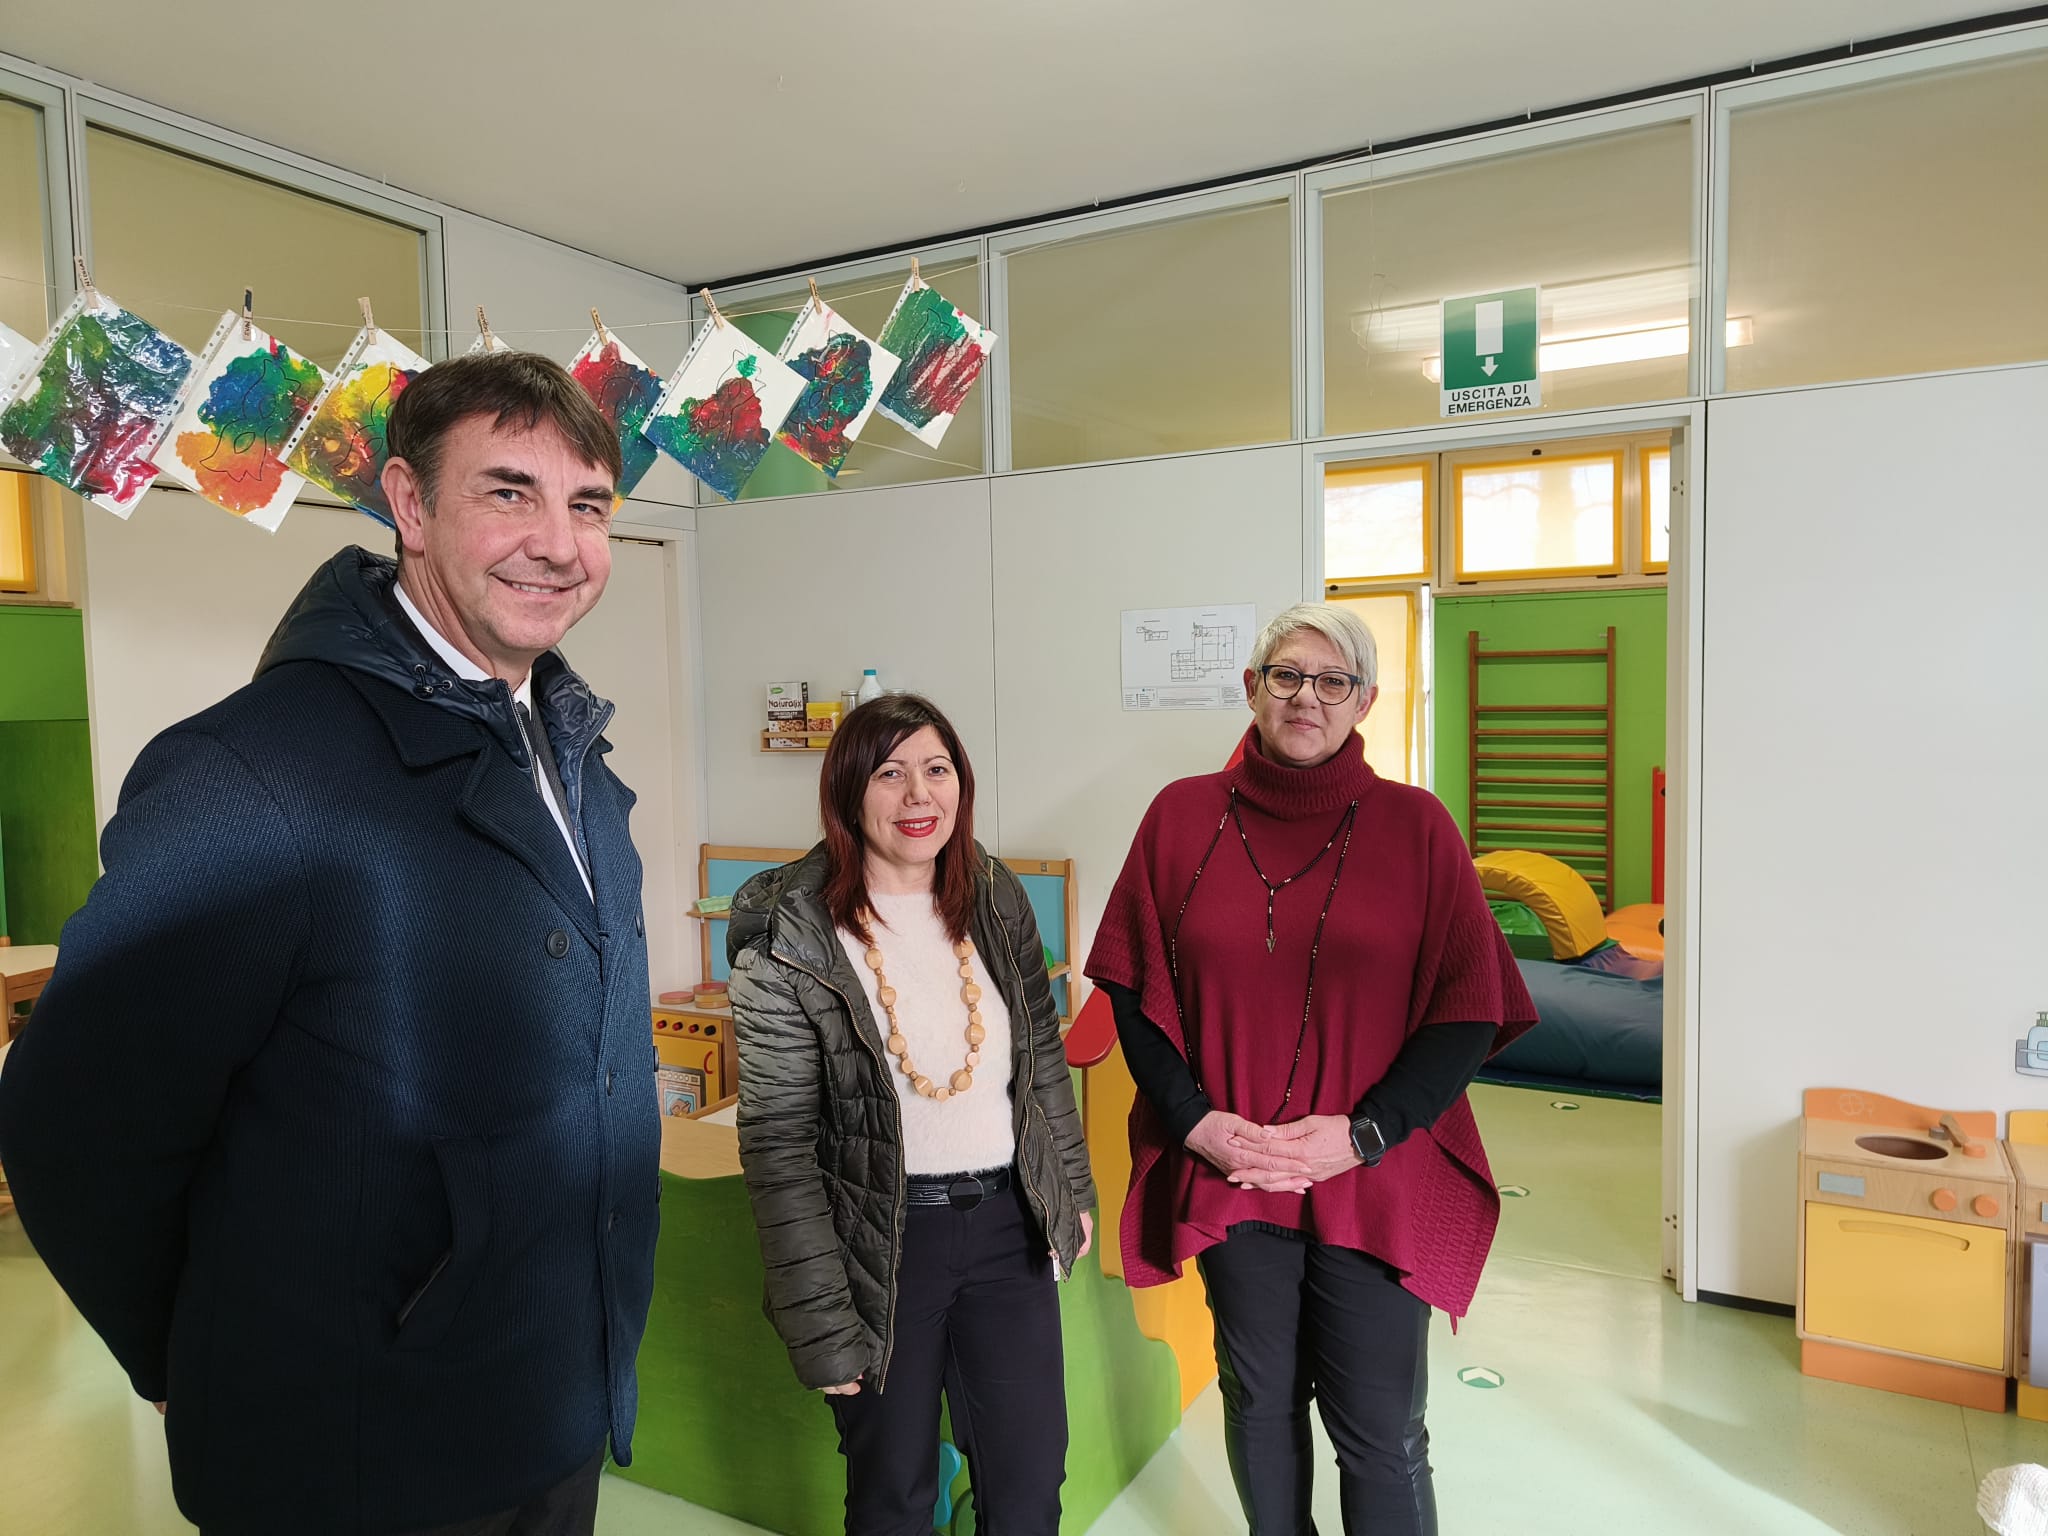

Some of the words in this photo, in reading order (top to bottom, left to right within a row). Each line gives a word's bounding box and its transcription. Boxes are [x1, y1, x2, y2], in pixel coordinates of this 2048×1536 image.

[1451, 387, 1506, 402] USCITA
[1513, 384, 1527, 395] DI
[1448, 396, 1531, 414] EMERGENZA
